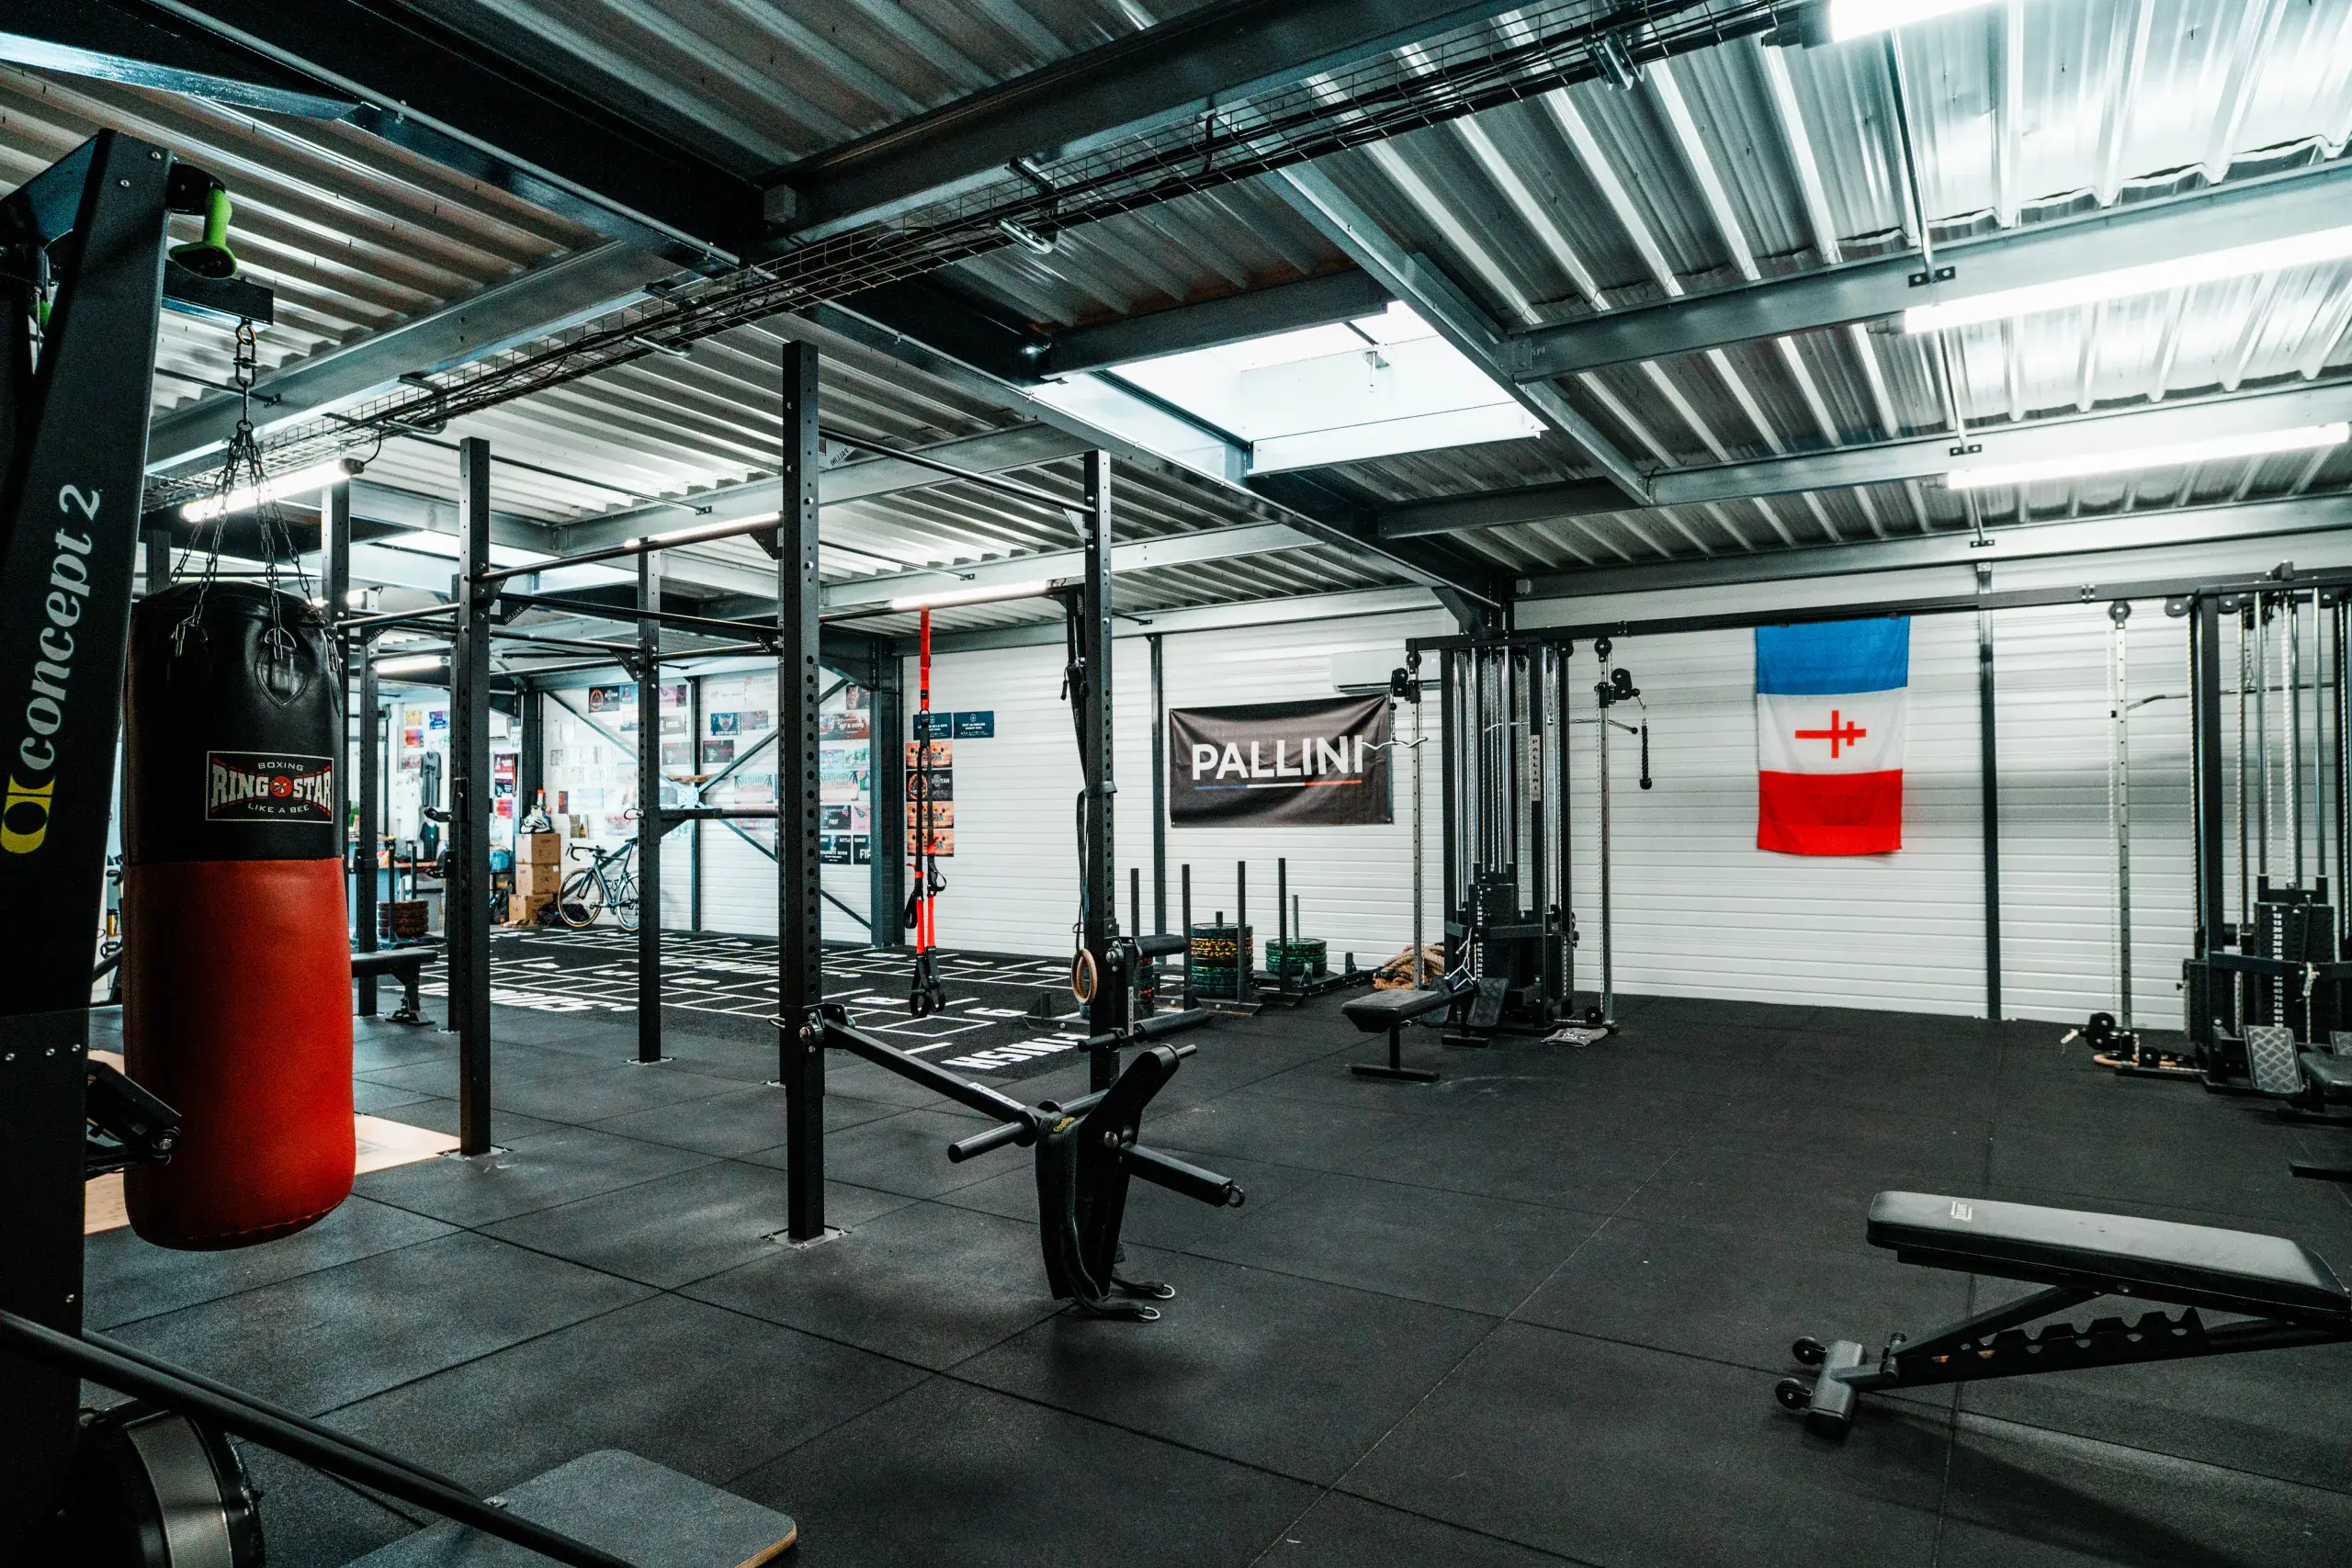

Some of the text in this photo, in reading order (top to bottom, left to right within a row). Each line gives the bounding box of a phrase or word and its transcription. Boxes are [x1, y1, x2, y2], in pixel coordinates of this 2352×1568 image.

[20, 484, 100, 770] concept 2
[257, 761, 304, 771] BOXING
[1193, 735, 1363, 780] PALLINI
[210, 763, 332, 811] RING STAR
[247, 802, 275, 813] LIKE
[289, 805, 310, 813] BEE
[849, 996, 911, 1006] 8
[963, 1007, 1029, 1017] 9
[940, 1032, 1091, 1069] FINISH
